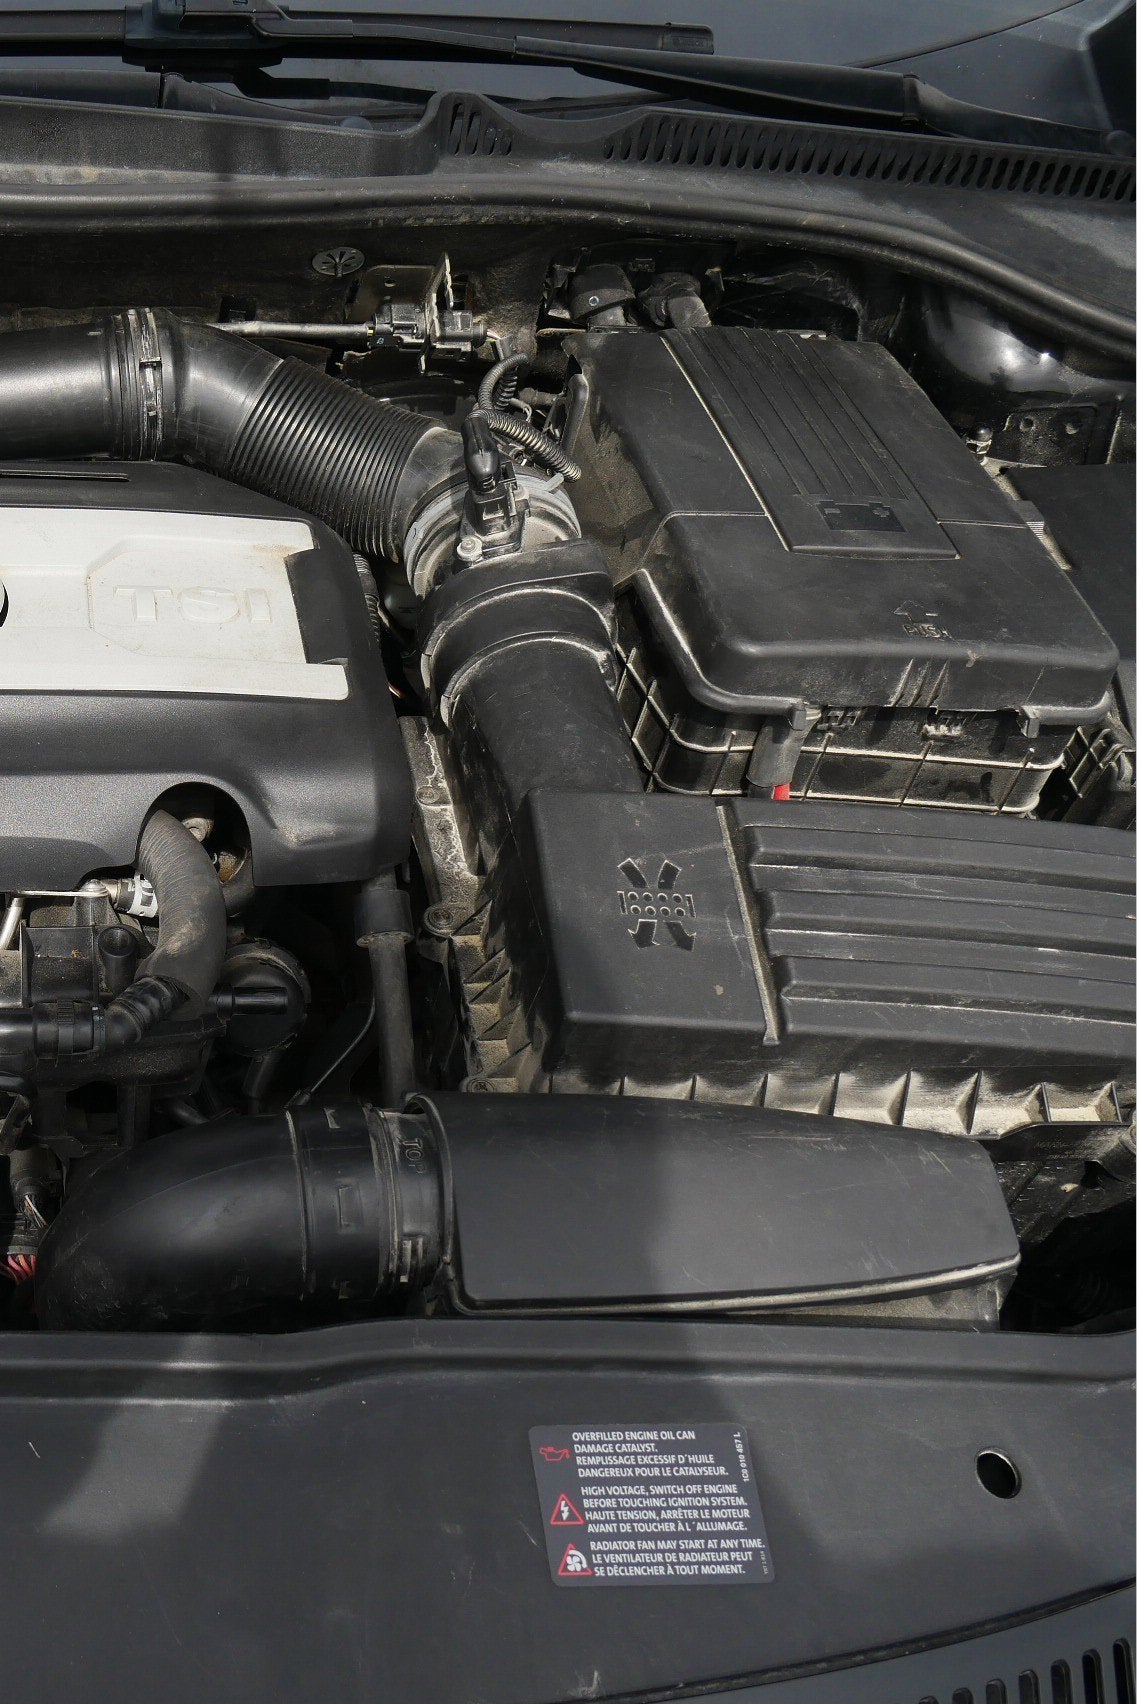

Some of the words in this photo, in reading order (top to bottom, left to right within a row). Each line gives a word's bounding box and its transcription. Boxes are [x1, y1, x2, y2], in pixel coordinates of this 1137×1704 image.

[115, 586, 272, 625] TSI
[403, 1138, 426, 1176] TOP
[573, 1432, 623, 1441] OVERFILLED
[626, 1432, 658, 1440] ENGINE
[660, 1431, 675, 1440] OIL
[677, 1431, 695, 1439] CAN
[574, 1444, 614, 1453] DAMAGE
[615, 1443, 657, 1452] CATALYST.
[577, 1456, 635, 1465] REMPLISSAGE
[637, 1456, 675, 1464] EXCESSIF
[579, 1468, 633, 1477] DANGEREUX
[636, 1468, 660, 1476] POUR
[662, 1468, 671, 1476] LE
[673, 1467, 728, 1475] CATALYSEUR.
[581, 1487, 605, 1495] HIGH
[606, 1486, 648, 1496] VOLTAGE,
[650, 1485, 684, 1494] SWITCH
[686, 1485, 703, 1493] OFF
[705, 1484, 737, 1493] ENGINE
[584, 1499, 619, 1508] BEFORE
[620, 1498, 666, 1507] TOUCHING
[669, 1497, 709, 1506] IGNITION
[711, 1497, 747, 1505] SYSTEM.
[585, 1511, 615, 1520] HAUTE
[616, 1510, 659, 1520] TENSION,
[661, 1508, 699, 1518] ARRÊTER
[701, 1509, 710, 1518] LE
[712, 1509, 750, 1518] MOTEUR
[588, 1523, 616, 1532] AVANT
[620, 1523, 633, 1532] DE
[634, 1522, 674, 1531] TOUCHER
[678, 1521, 685, 1531] À
[590, 1541, 635, 1550] RADIATOR
[637, 1541, 656, 1549] FAN
[657, 1540, 677, 1549] MAY
[679, 1540, 705, 1549] START
[708, 1539, 718, 1548] AT
[720, 1539, 738, 1548] ANY
[740, 1539, 765, 1548] TIME.
[592, 1554, 602, 1563] LE
[604, 1553, 663, 1562] VENTILATEUR
[665, 1552, 677, 1561] DE
[679, 1552, 729, 1561] RADIATEUR
[731, 1551, 752, 1560] PEUT
[595, 1567, 604, 1576] SE
[667, 1564, 675, 1574] À
[675, 1565, 699, 1574] TOUT
[701, 1565, 745, 1574] MOMENT.
